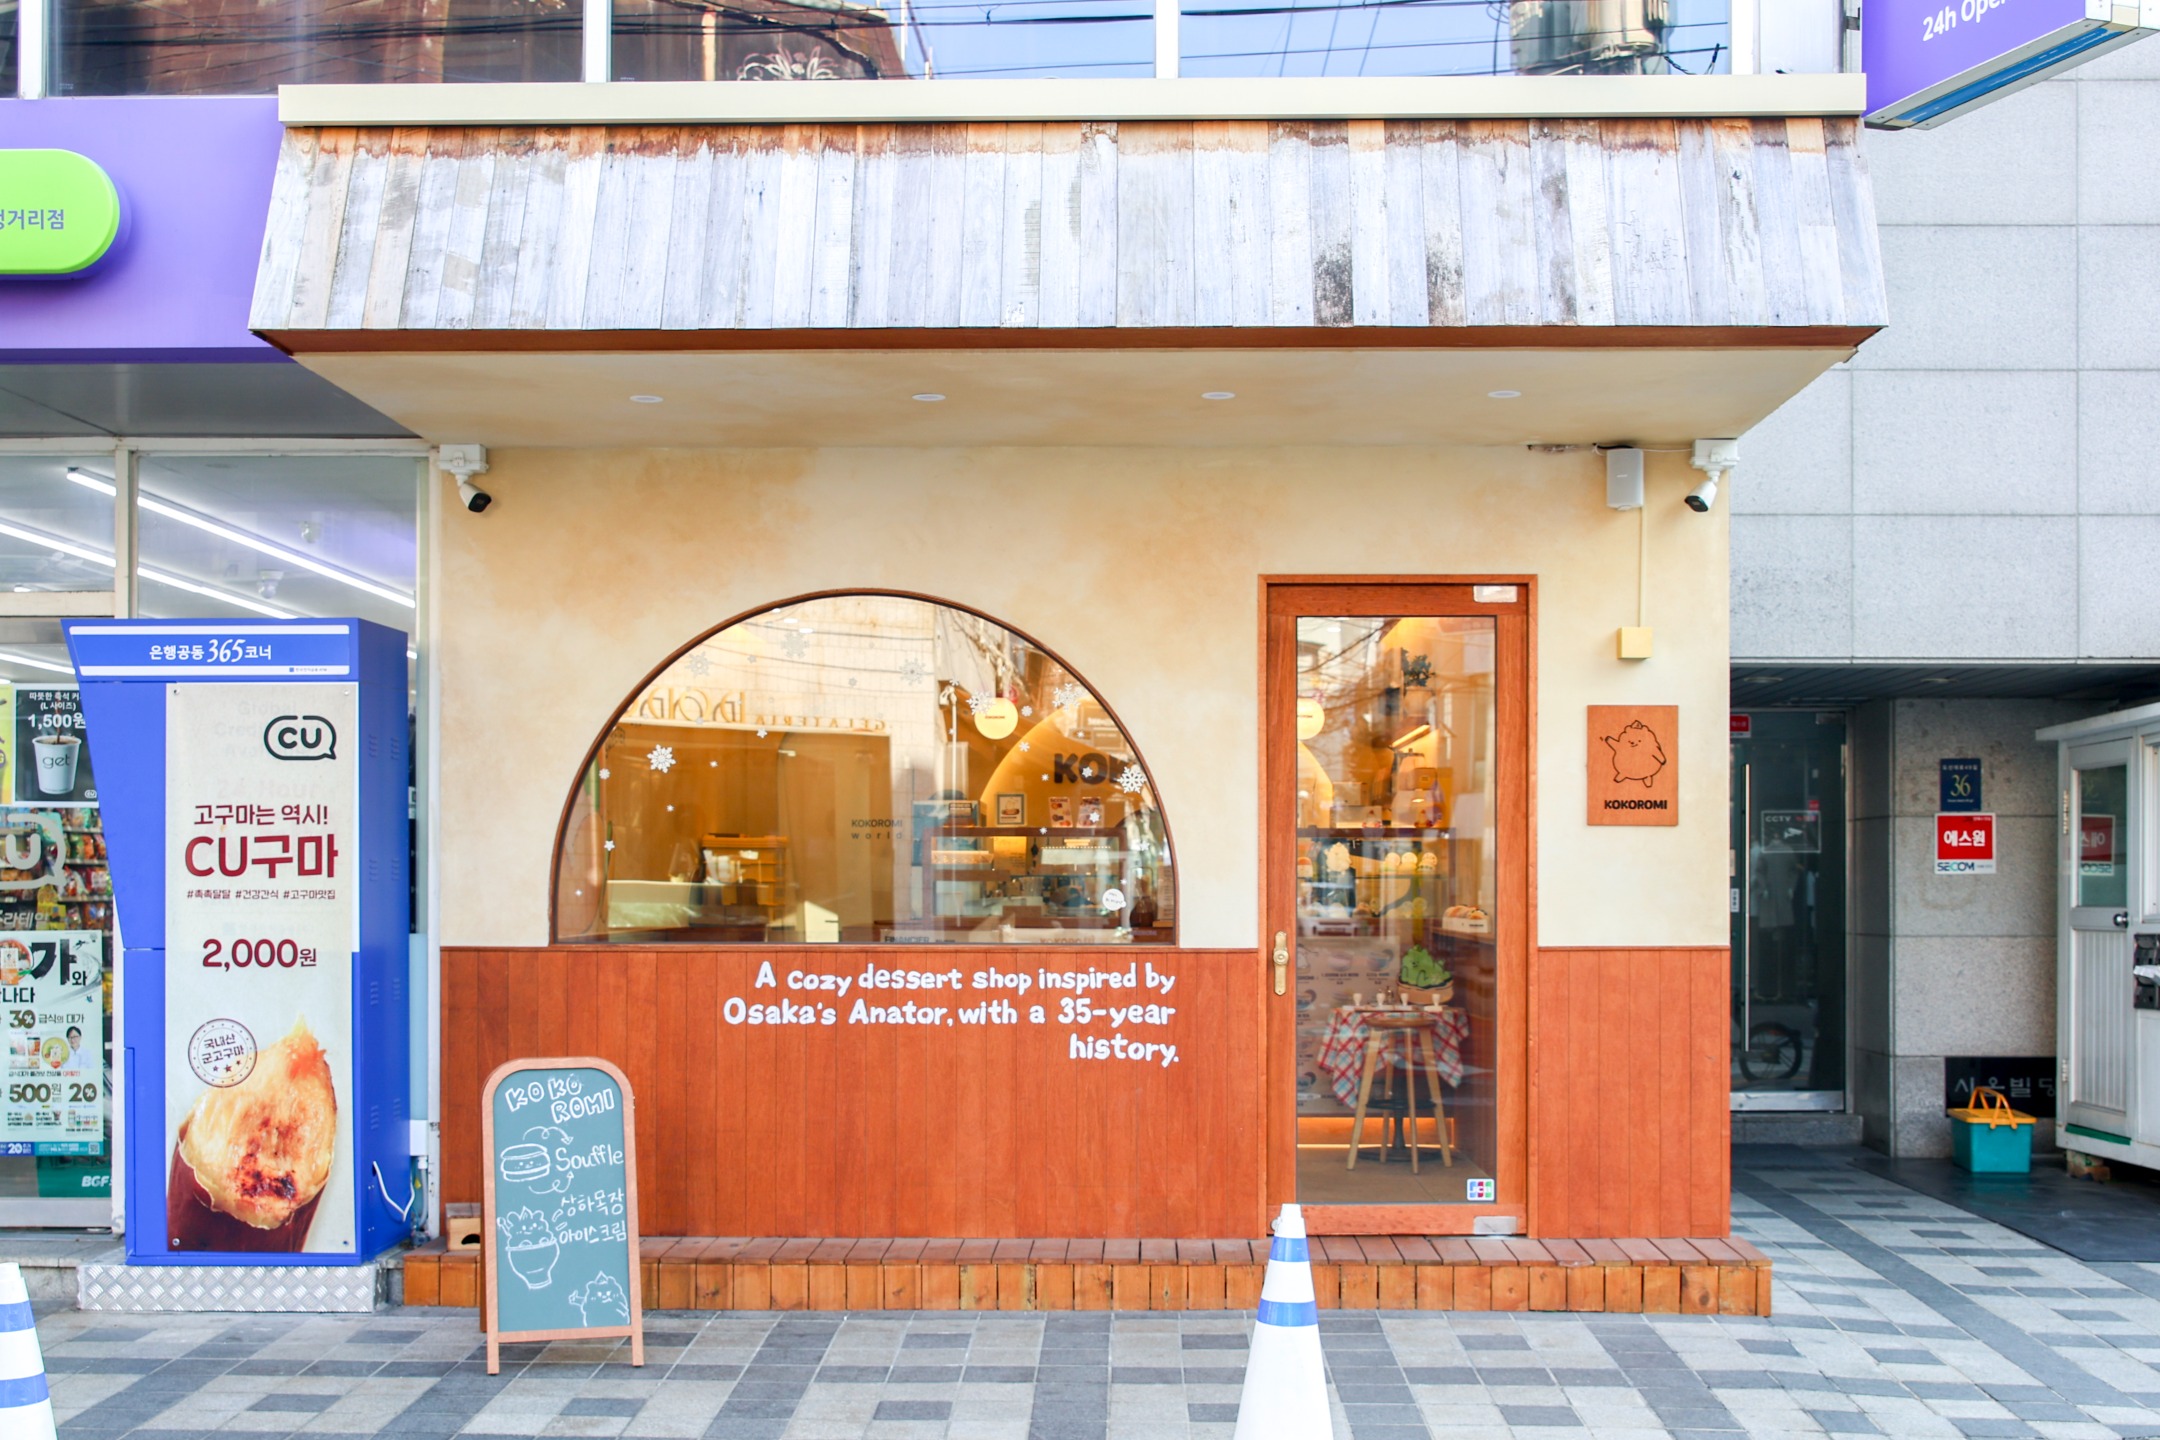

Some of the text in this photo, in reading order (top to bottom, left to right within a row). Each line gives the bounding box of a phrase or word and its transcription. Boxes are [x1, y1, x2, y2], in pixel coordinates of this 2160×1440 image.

[1923, 6, 1957, 42] 24h
[149, 644, 205, 661] 은행공동
[72, 692, 81, 701] 커
[28, 712, 87, 731] 1,500원
[278, 727, 322, 750] CU
[42, 753, 71, 769] get
[1950, 774, 1971, 797] 36
[194, 804, 328, 825] 고구마는 역시!
[1604, 799, 1668, 810] KOKOROMI
[851, 819, 903, 828] KOKOROMI
[1765, 815, 1792, 824] CCTV
[1943, 829, 1985, 847] 에스원
[185, 834, 338, 878] CU구마
[1937, 861, 1975, 871] SECOM
[235, 889, 279, 900] #건강간식
[283, 889, 336, 900] #고구마맛집
[202, 938, 317, 973] 2,000원
[755, 960, 1176, 997] A cozy dessert shop inspired by
[0, 987, 36, 1004] 나다
[723, 996, 837, 1025] Osaka's
[958, 998, 1018, 1025] with
[1029, 1004, 1046, 1025] a
[1057, 996, 1176, 1028] 35-year
[203, 1033, 236, 1049] 국내산
[1069, 1033, 1179, 1068] history.
[201, 1044, 245, 1065] 군고구마
[551, 1088, 615, 1124] ROMI
[555, 1143, 625, 1173] Souffle
[81, 1175, 112, 1188] BGF
[561, 1187, 625, 1218] 상하목장
[558, 1219, 627, 1245] 아이스크림
